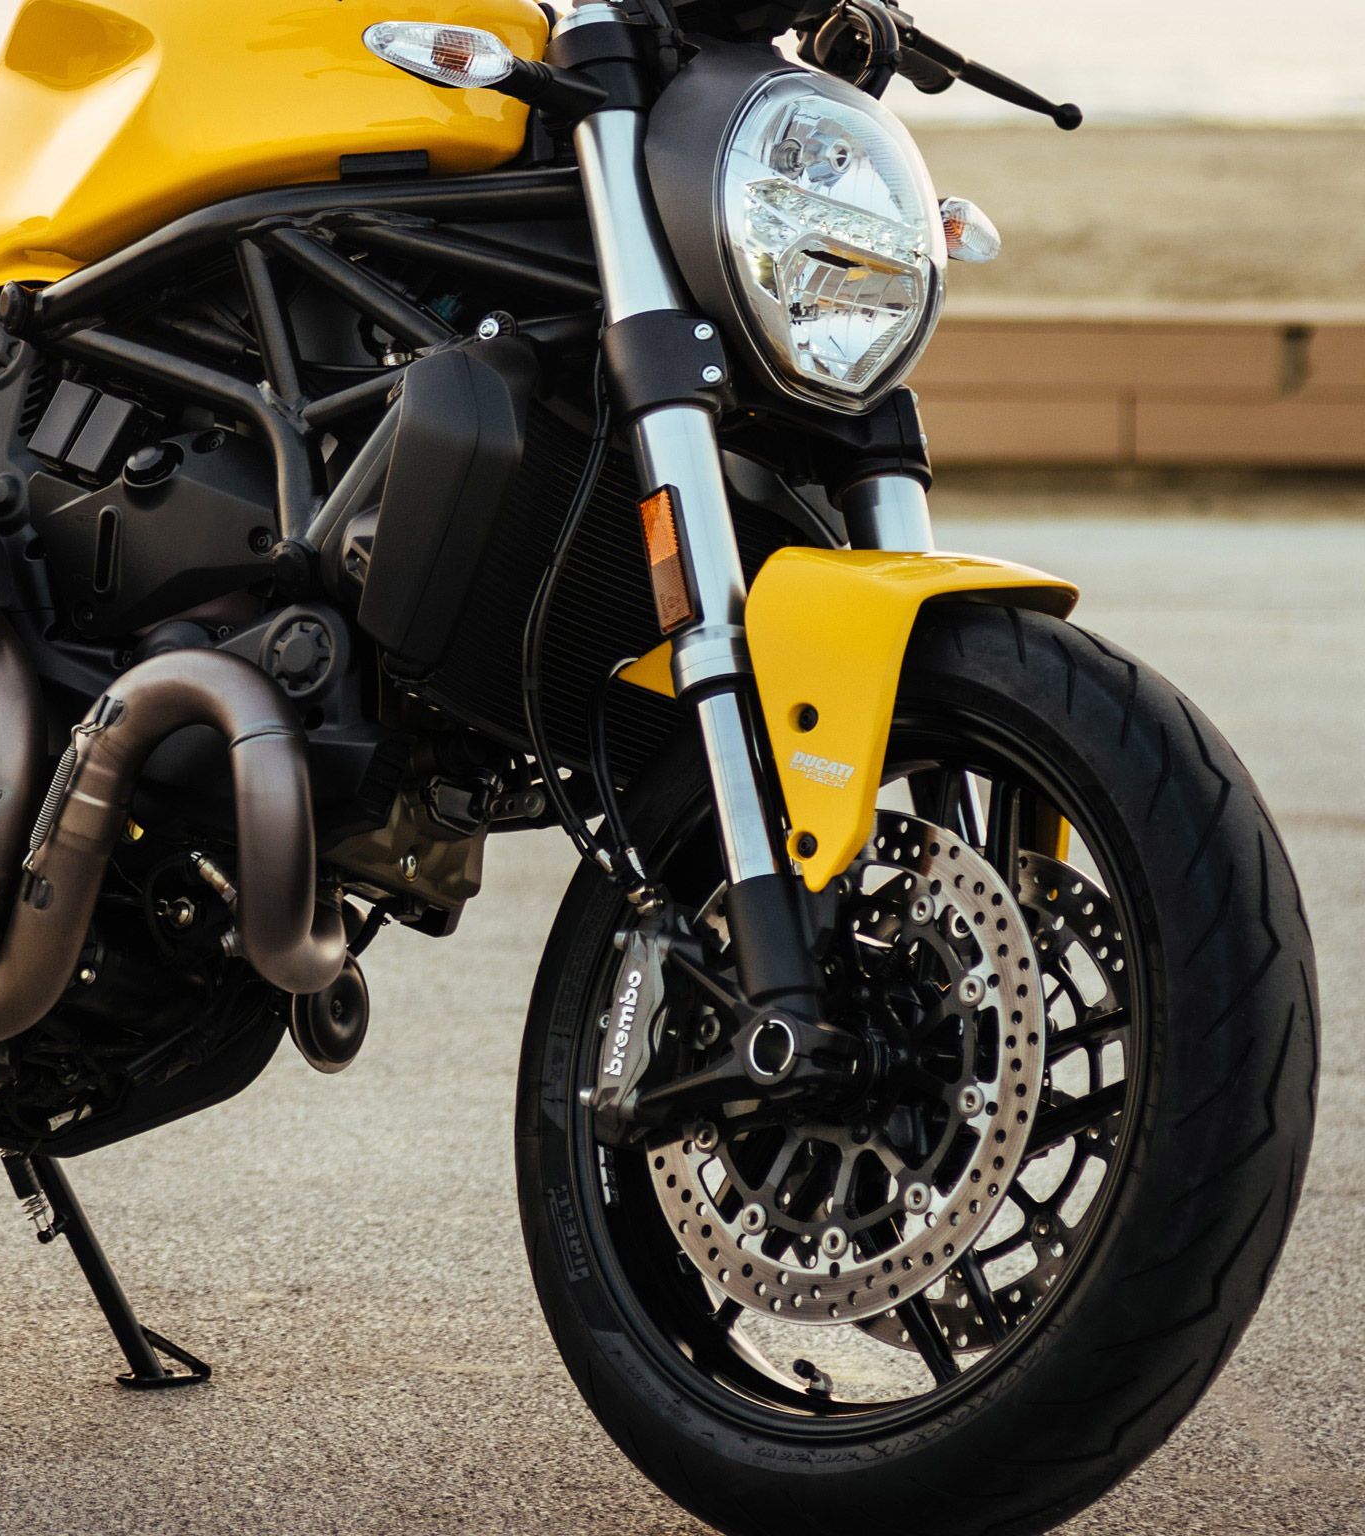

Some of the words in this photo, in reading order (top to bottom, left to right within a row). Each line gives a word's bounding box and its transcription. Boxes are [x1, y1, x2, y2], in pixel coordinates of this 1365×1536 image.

[791, 751, 855, 778] DUCATI
[604, 970, 642, 1076] brembo
[548, 1185, 590, 1282] PIRELLI
